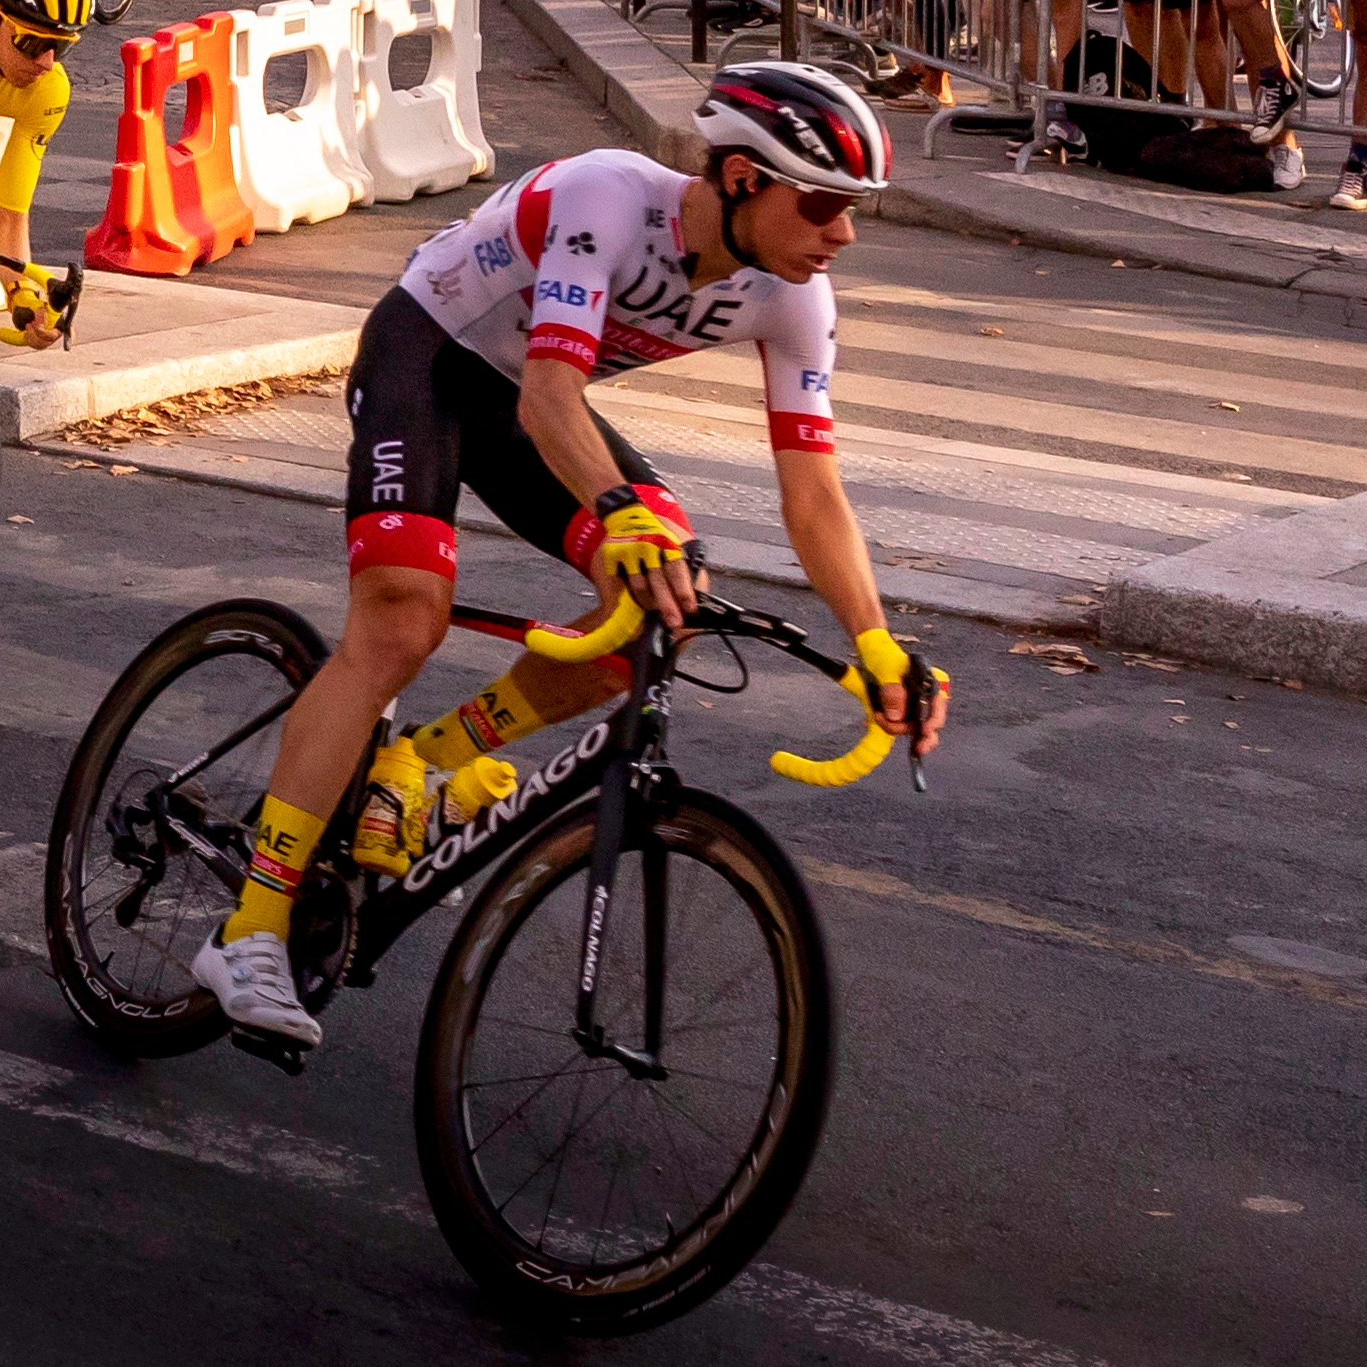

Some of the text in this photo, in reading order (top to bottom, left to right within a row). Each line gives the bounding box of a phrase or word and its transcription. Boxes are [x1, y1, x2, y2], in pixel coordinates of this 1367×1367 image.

[617, 266, 742, 342] UAE
[801, 369, 829, 392] FA
[372, 441, 404, 504] UAE
[481, 691, 518, 730] AE
[403, 722, 609, 893] COLNAGO
[582, 897, 603, 991] COLNAGO
